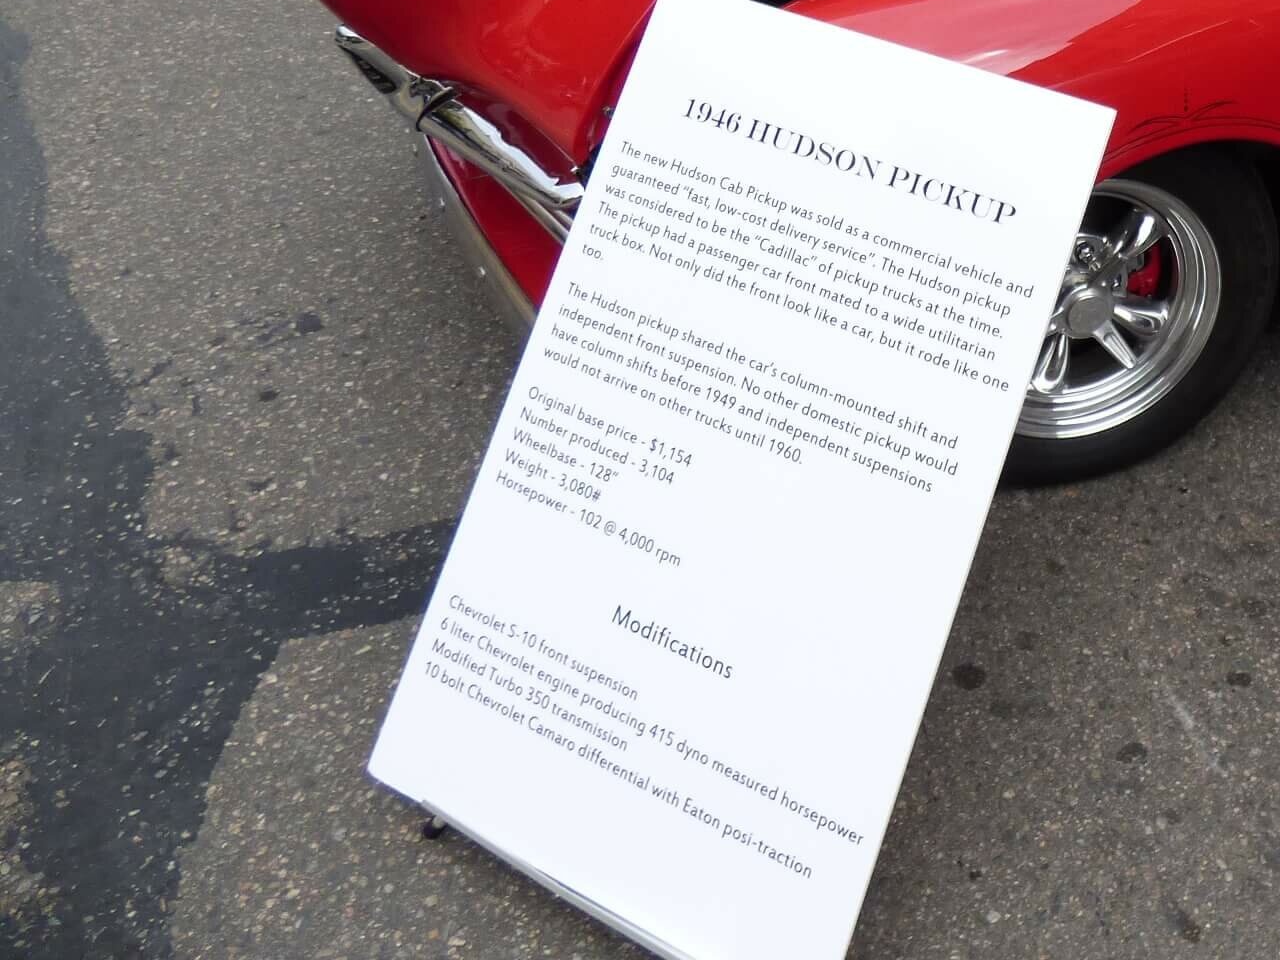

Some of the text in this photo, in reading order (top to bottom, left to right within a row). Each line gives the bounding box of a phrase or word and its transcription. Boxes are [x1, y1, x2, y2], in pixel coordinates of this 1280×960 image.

[620, 139, 1036, 300] The new Hudson Cab Pickup was sold commercial vehicle and
[682, 97, 1018, 225] 1946 HUDSON PICKUP
[581, 243, 605, 262] too.
[597, 199, 997, 362] The pickup had passenger car front mated wide utilitarian
[604, 183, 628, 201] was
[627, 192, 696, 225] considered
[710, 218, 728, 238] be
[728, 226, 752, 247] the
[831, 268, 880, 296] pickup
[881, 284, 924, 310] trucks
[941, 304, 966, 326] the
[967, 315, 1004, 340] time.
[609, 163, 682, 197] guaranteed
[713, 196, 769, 229] low-cost
[768, 217, 822, 251] delivery
[880, 255, 906, 279] The
[906, 265, 962, 299] Hudson
[961, 290, 1012, 320] pickup
[567, 280, 589, 303] The
[589, 290, 637, 322] Hudson
[635, 313, 681, 342] pickup
[680, 328, 726, 357] shared
[724, 345, 747, 366] the
[779, 370, 897, 426] column-mounted
[896, 415, 929, 439] shift
[929, 431, 960, 451] and
[589, 222, 1010, 393] truck box. Not only did the front look like car, but rode like one
[512, 426, 578, 469] Wheelbase
[518, 405, 676, 486] Number produced 3,104
[527, 385, 578, 418] Original
[575, 406, 606, 431] base
[604, 422, 639, 445] price
[543, 346, 803, 466] would not arrive other trucks until 1960.
[550, 322, 934, 494] have column shifts before 1949 and independent suspensions
[557, 302, 960, 477] independent front suspension. No other domestic pickup would
[494, 468, 682, 568] Horsepower 102 @ 4,000 rpm
[504, 446, 549, 481] Weight
[430, 637, 629, 753] Modified Turbo 350 transmission
[448, 593, 639, 702] Chevrolet S-10 front suspension
[610, 603, 734, 680] Modifications
[424, 660, 813, 880] 10 bolt Chevrolet Camaro differential with Eaton posi-traction
[439, 616, 865, 846] 6 liter Chevrolet engine producing 415 dyno measured horsepower
